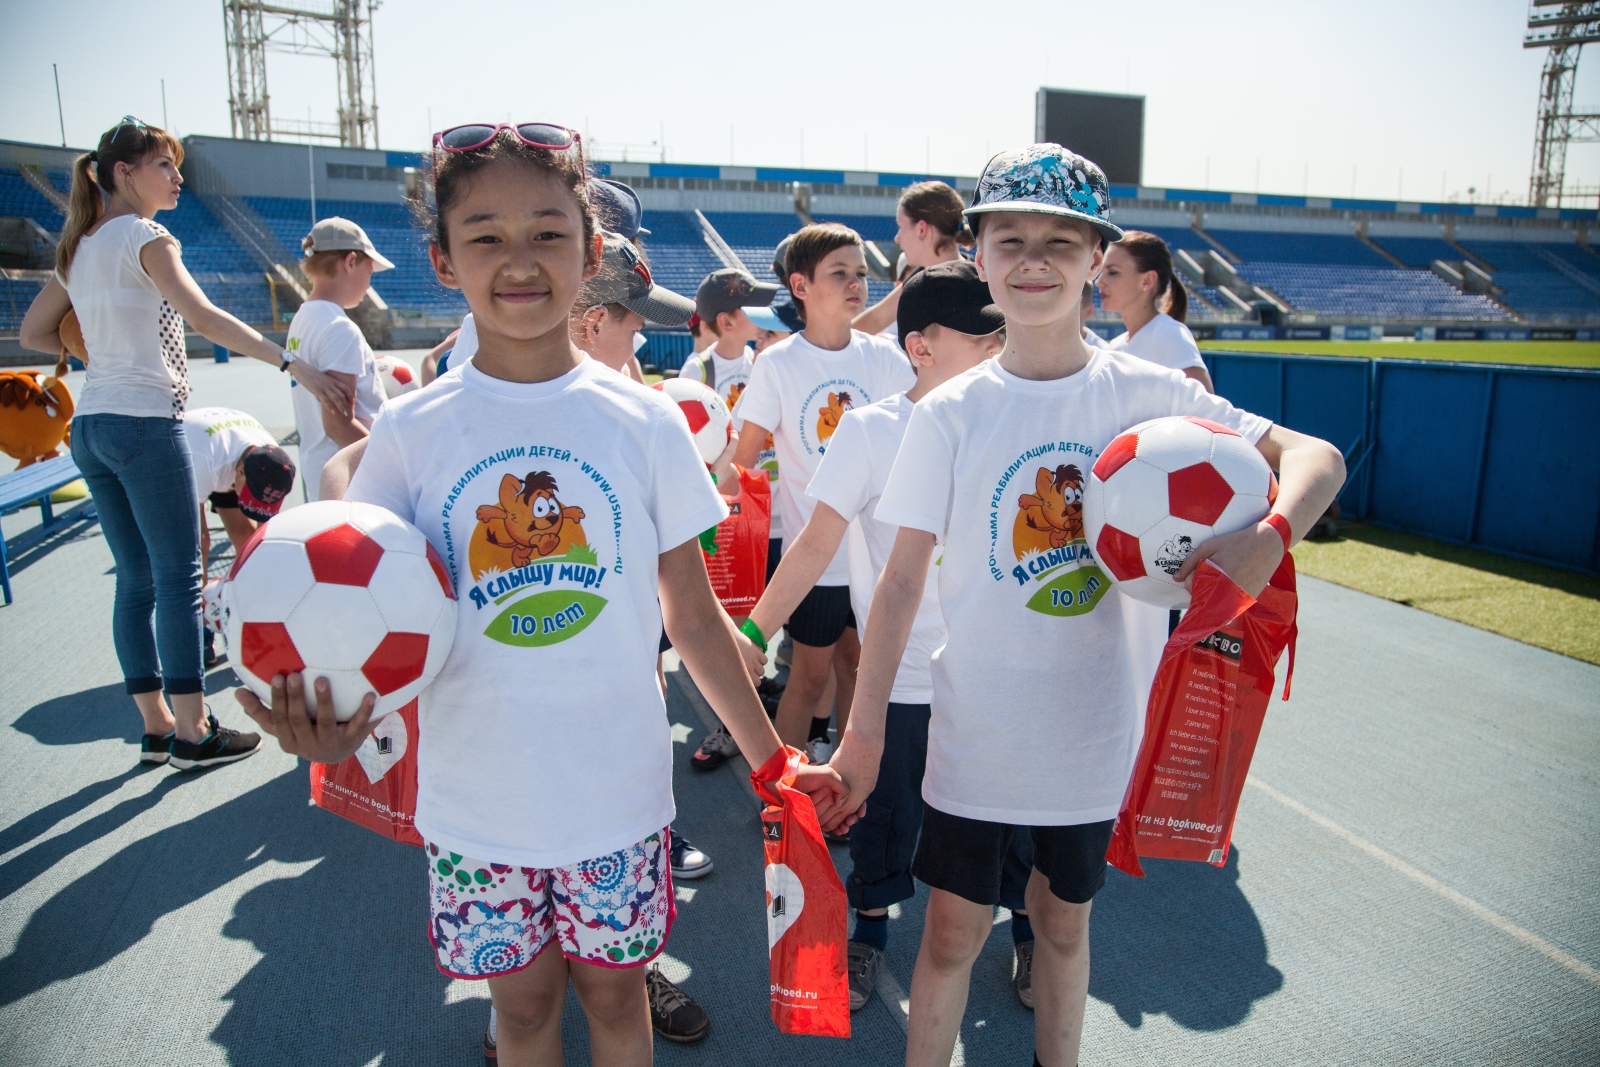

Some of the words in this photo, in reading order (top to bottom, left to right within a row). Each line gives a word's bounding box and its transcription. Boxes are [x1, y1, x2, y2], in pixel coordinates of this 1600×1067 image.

[801, 379, 836, 413] РЕАБИЛИТАЦИИ
[204, 419, 262, 437] ШАРИК
[528, 445, 571, 462] ДЕТЕЙ
[442, 446, 525, 518] РЕАБИЛИТАЦИИ
[991, 441, 1055, 509] РЕАБИЛИТАЦИИ
[1058, 441, 1093, 457] ДЕТЕЙ
[442, 522, 459, 600] ОГРАММА
[1012, 564, 1031, 586] Я
[1028, 545, 1079, 575] слыш
[469, 585, 489, 611] Я
[1051, 589, 1074, 607] 10
[511, 614, 537, 635] 10
[542, 602, 585, 634] лет
[320, 776, 334, 788] Все
[335, 784, 358, 799] книги
